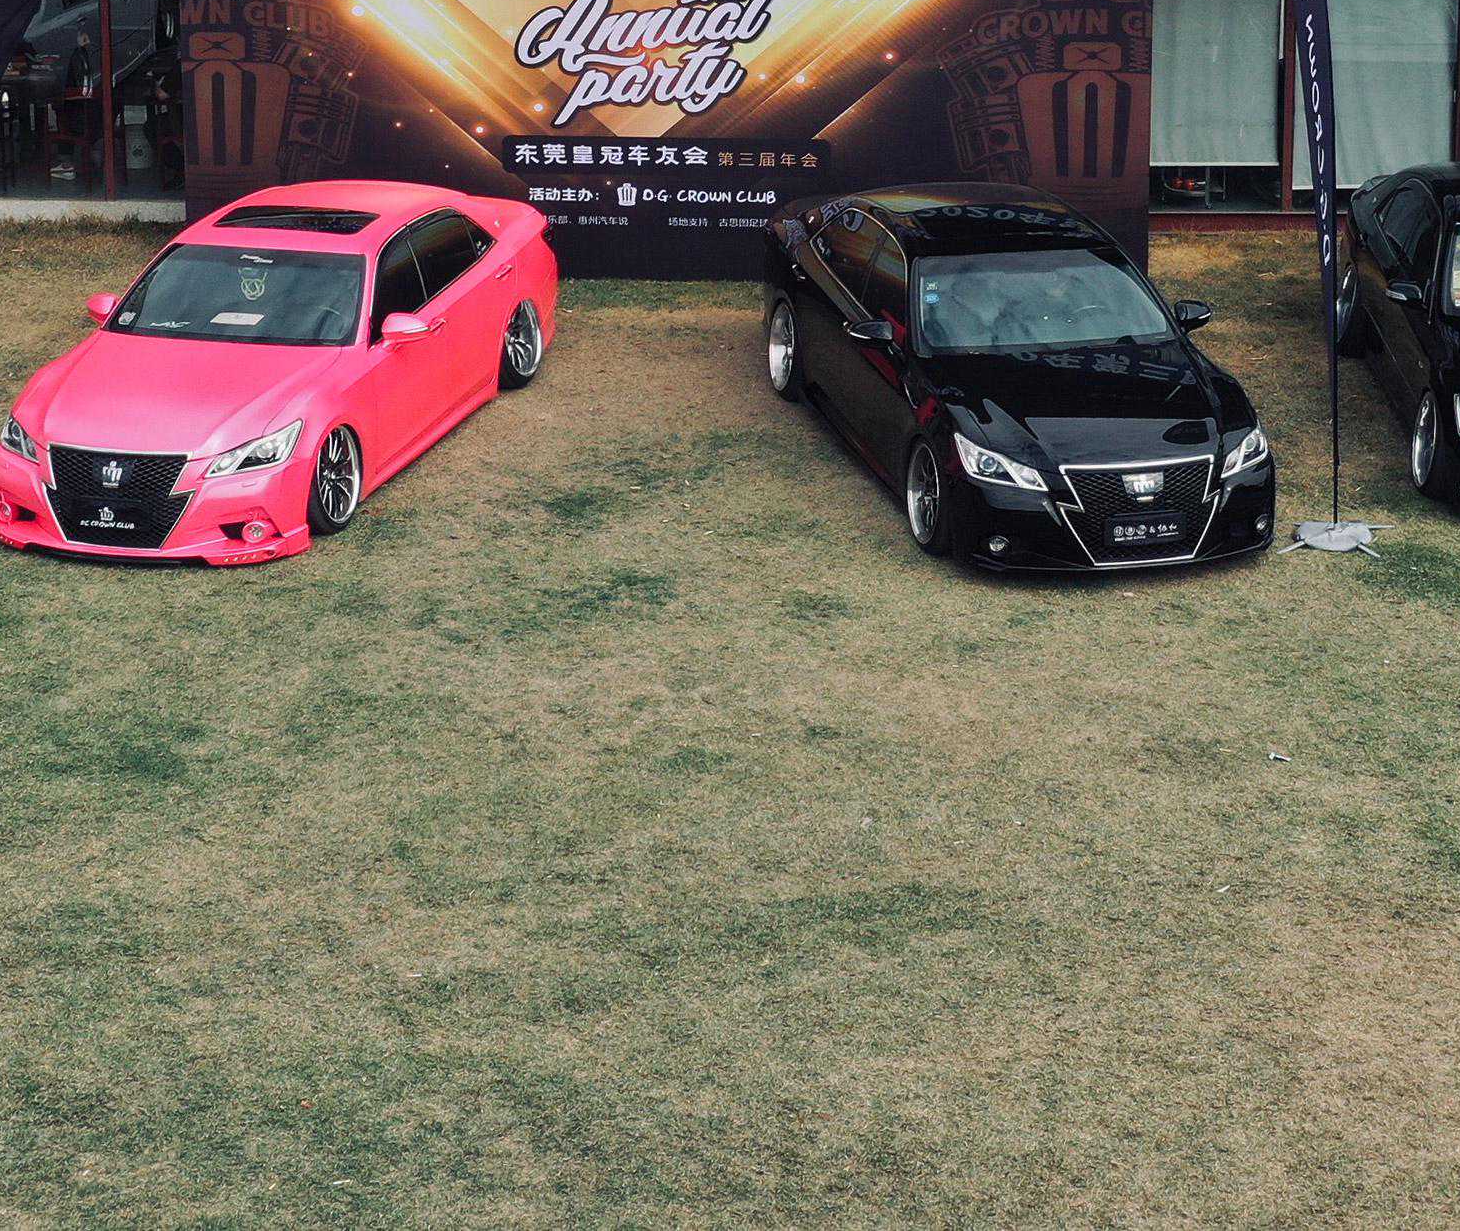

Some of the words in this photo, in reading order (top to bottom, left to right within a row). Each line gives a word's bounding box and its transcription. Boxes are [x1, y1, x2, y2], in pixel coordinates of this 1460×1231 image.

[973, 8, 1109, 41] CROWN
[552, 41, 748, 127] party
[514, 144, 709, 166] 东莞皇冠车友会
[717, 151, 819, 169] 第三届年会
[677, 189, 732, 204] CROWN
[736, 189, 777, 204] CLUB
